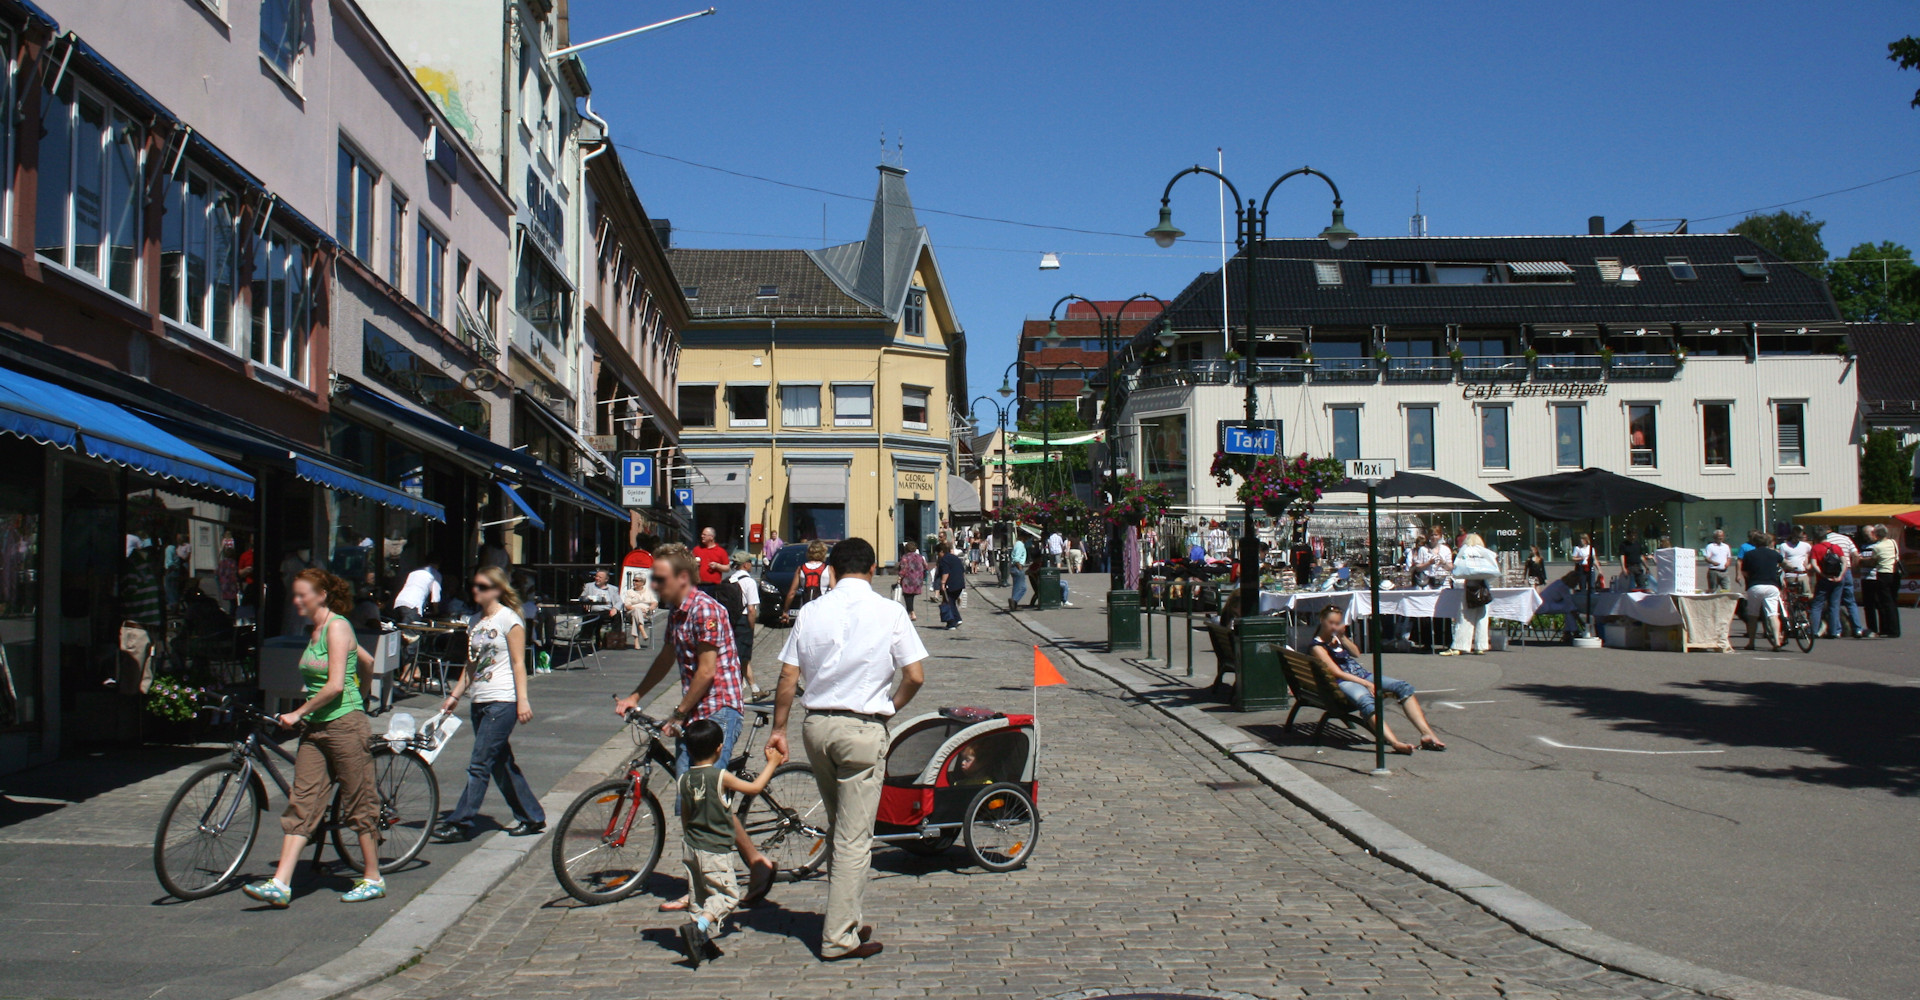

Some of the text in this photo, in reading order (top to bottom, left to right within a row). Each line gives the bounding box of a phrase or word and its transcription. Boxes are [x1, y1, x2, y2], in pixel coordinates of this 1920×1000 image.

[1233, 431, 1268, 449] Taxi
[630, 461, 646, 484] P
[1353, 462, 1382, 476] Maxi
[904, 473, 927, 483] GEORG
[898, 481, 934, 491] MARTINSEN
[679, 490, 690, 503] P
